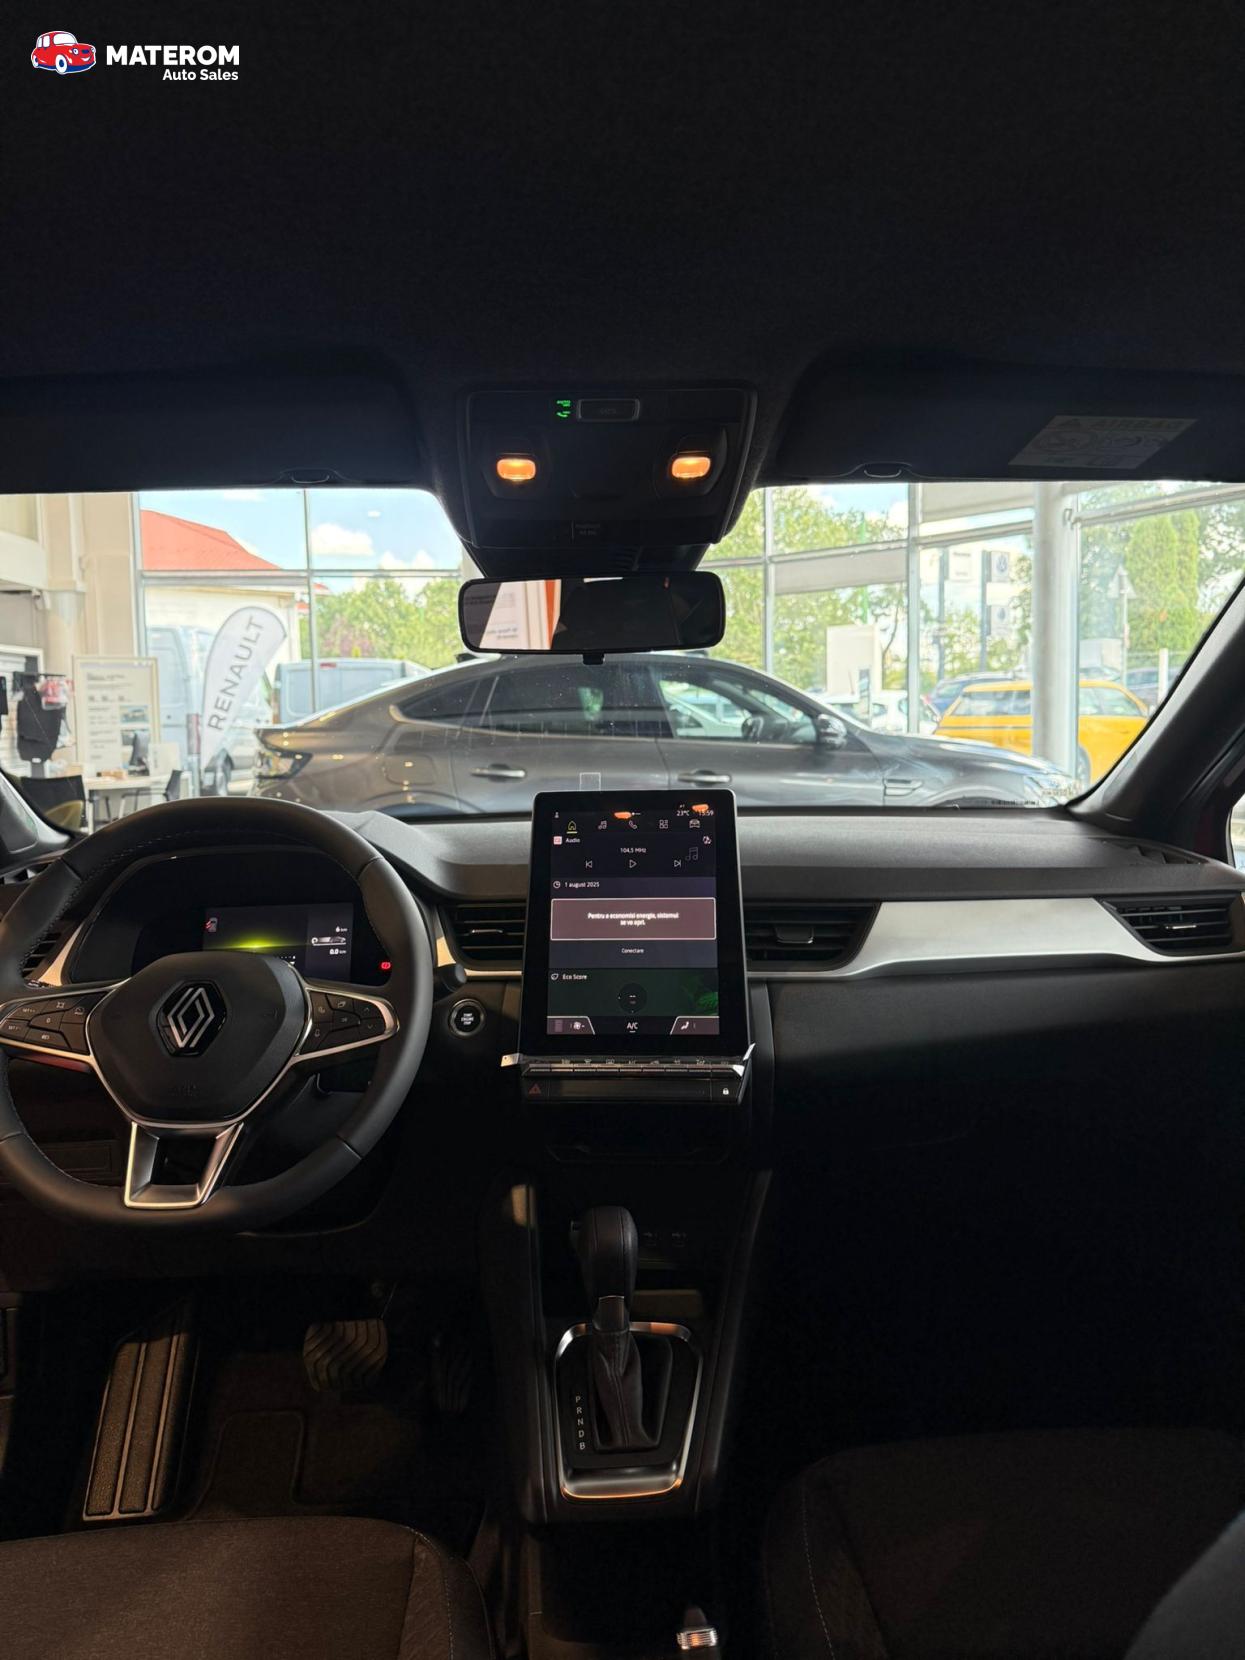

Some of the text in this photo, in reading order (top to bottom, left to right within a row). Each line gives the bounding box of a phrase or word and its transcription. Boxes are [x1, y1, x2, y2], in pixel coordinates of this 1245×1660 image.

[207, 616, 263, 731] RENAULT
[626, 1021, 638, 1030] A/C
[575, 1395, 581, 1403] P
[576, 1406, 582, 1414] R
[577, 1417, 584, 1426] N
[578, 1429, 585, 1438] D
[579, 1441, 586, 1450] B
